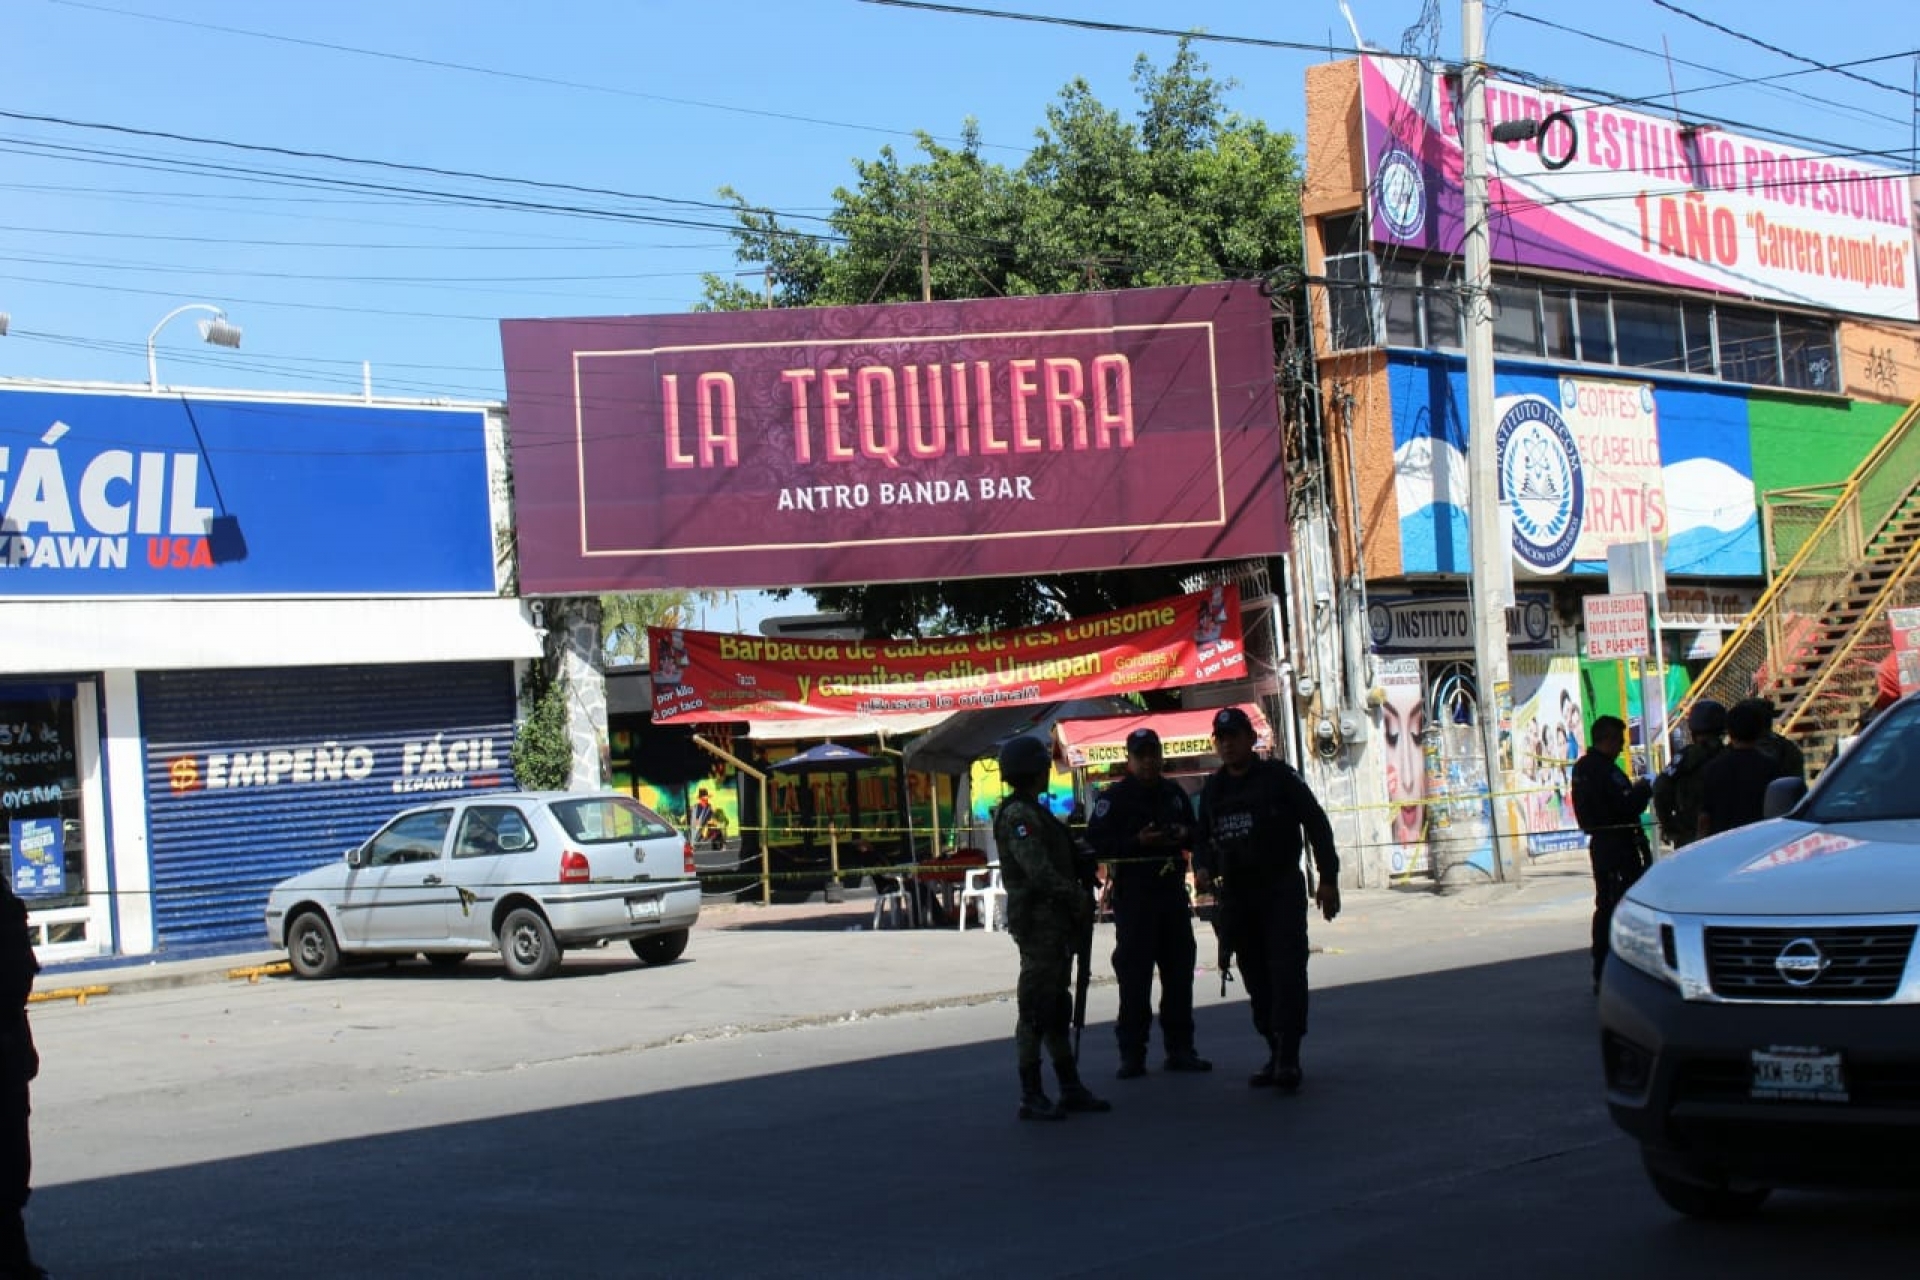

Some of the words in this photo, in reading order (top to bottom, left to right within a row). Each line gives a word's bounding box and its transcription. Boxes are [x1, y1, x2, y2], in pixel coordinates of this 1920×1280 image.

[1438, 75, 1578, 161] ETUDIA
[1585, 109, 1737, 192] ESTILISMO
[1743, 146, 1907, 228] PROFESIONAL
[1635, 190, 1650, 252] 1
[1659, 191, 1738, 266] AÑO
[663, 372, 739, 469] LA
[781, 354, 1134, 468] TEQUILERA
[1578, 387, 1636, 419] CORTES
[1591, 435, 1659, 466] CABELLO
[0, 420, 214, 534] ÁCIL
[777, 485, 871, 512] ANTRO
[879, 479, 970, 505] BANDA
[980, 476, 1035, 500] BAR
[1395, 610, 1468, 638] INSTITUTO
[1115, 651, 1167, 670] Gorditas
[1198, 649, 1216, 663] por
[1590, 640, 1603, 655] EL
[1606, 638, 1646, 654] PUENTE
[797, 674, 812, 706] y
[818, 665, 917, 697] carnitas
[923, 659, 988, 689] estilo
[995, 652, 1101, 686] Uruapan
[1110, 665, 1186, 686] Quesadillas
[1204, 663, 1222, 677] por
[657, 693, 675, 705] por
[676, 685, 695, 697] kilo
[661, 706, 678, 719] por
[680, 698, 704, 711] taco
[206, 741, 375, 788] EMPEÑO
[402, 732, 499, 775] FÁCIL
[1088, 745, 1120, 761] RICOS
[1173, 739, 1213, 755] CABEZA
